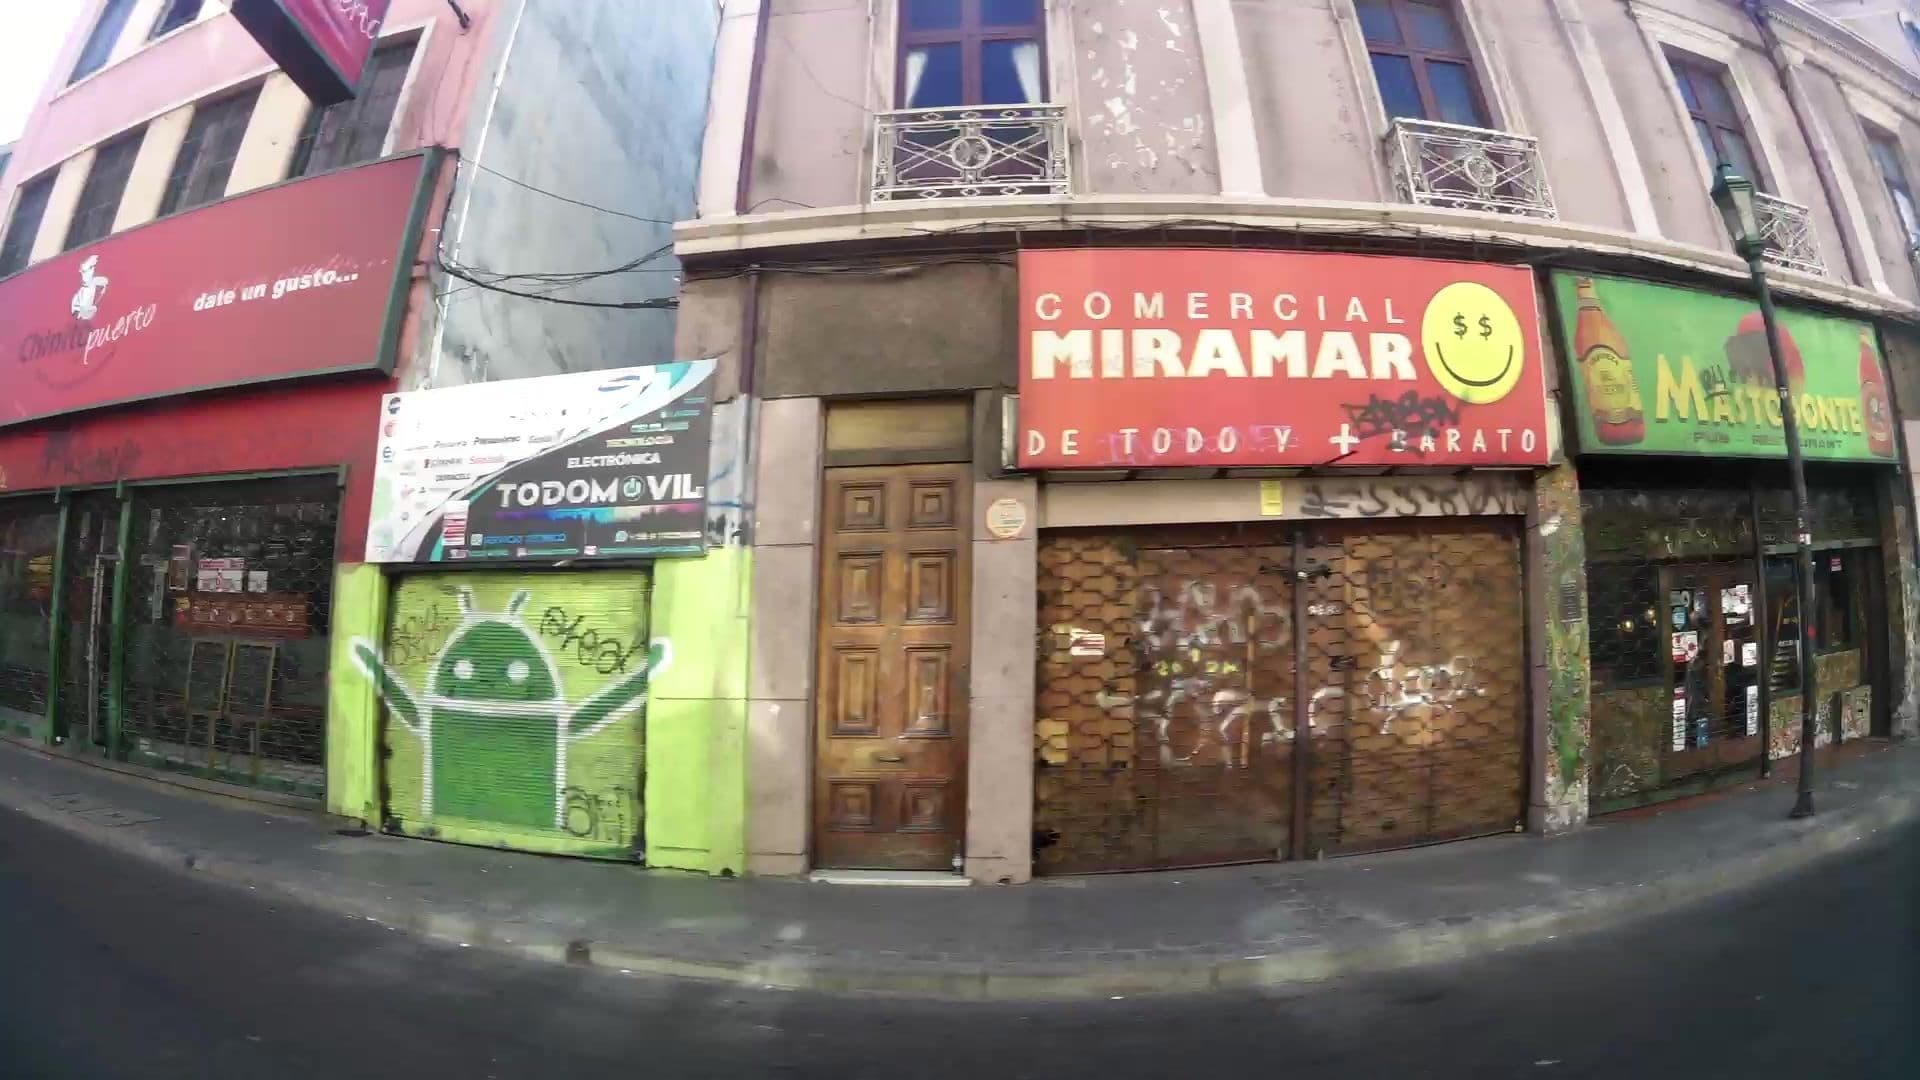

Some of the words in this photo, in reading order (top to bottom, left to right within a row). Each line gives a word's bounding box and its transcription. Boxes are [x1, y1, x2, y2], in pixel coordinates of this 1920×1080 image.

[193, 288, 236, 311] date
[241, 282, 267, 301] un
[1035, 291, 1404, 324] COMERCIAL
[84, 303, 157, 365] puerto
[1031, 328, 1416, 380] MIRAMAR
[1028, 428, 1080, 456] DE
[1118, 426, 1238, 455] TODO
[1273, 427, 1293, 454] Y
[1391, 428, 1537, 452] BARATO
